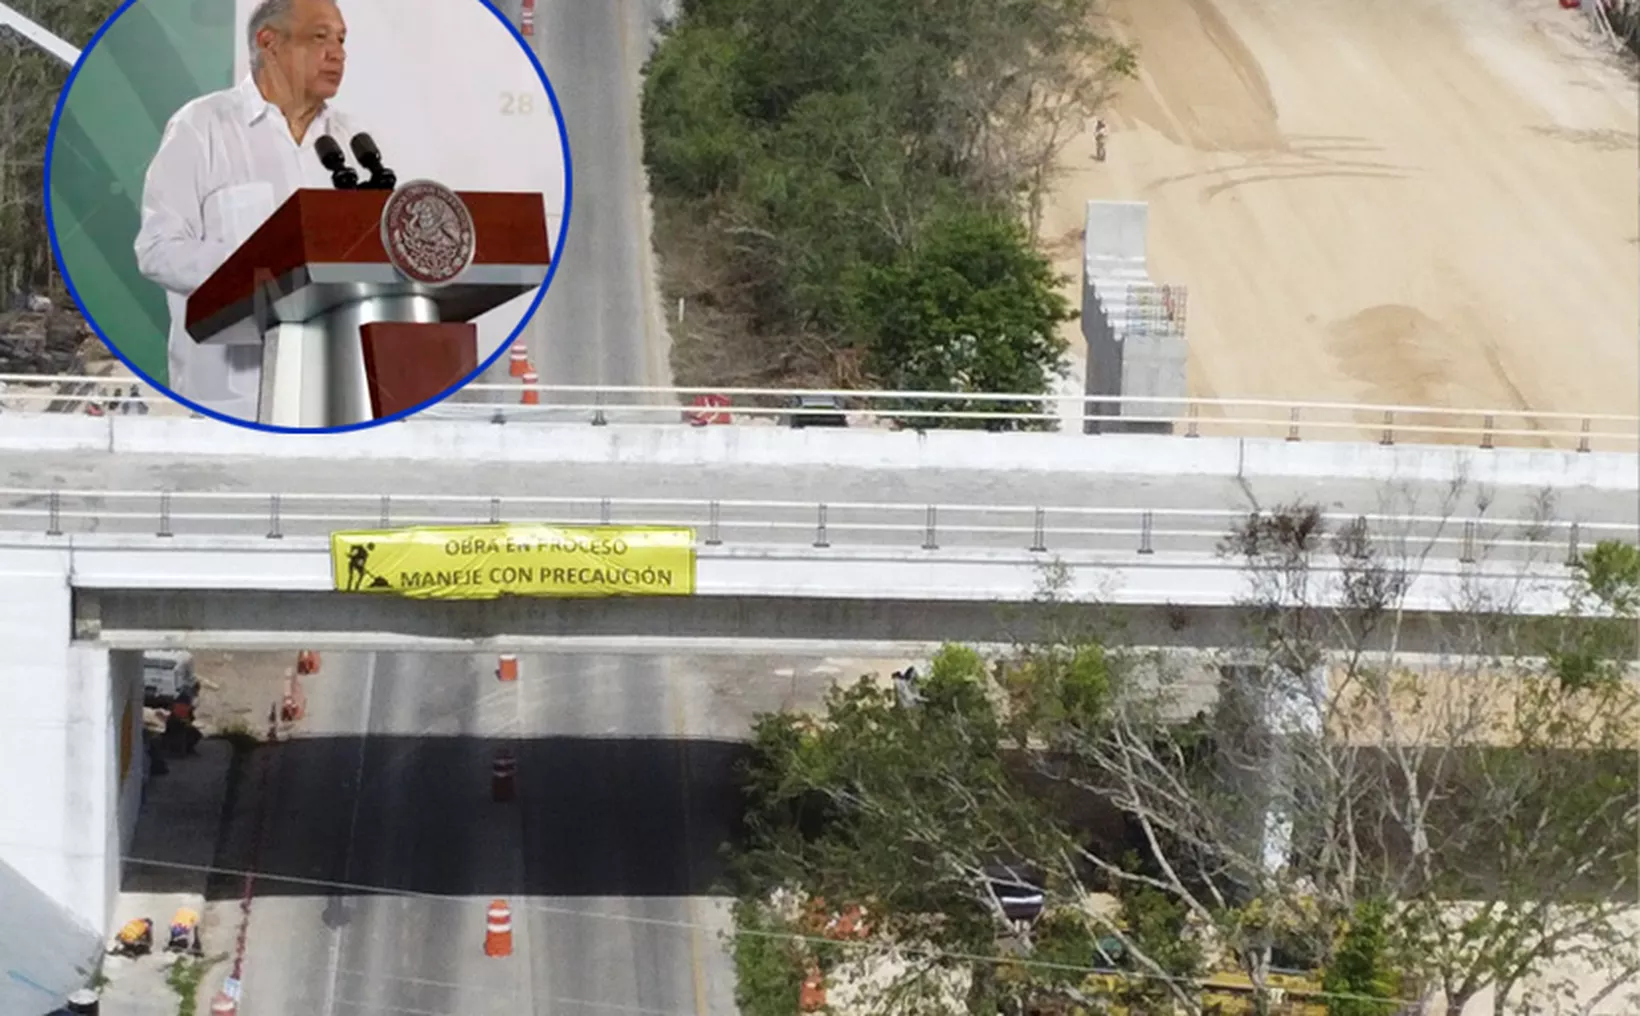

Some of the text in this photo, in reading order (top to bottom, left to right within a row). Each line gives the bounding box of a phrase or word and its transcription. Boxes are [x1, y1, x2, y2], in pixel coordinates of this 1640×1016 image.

[499, 92, 534, 116] 28
[445, 538, 628, 557] OBRA EN PROCESO
[400, 564, 673, 587] MANEJE CON PRECAUCIÓN
